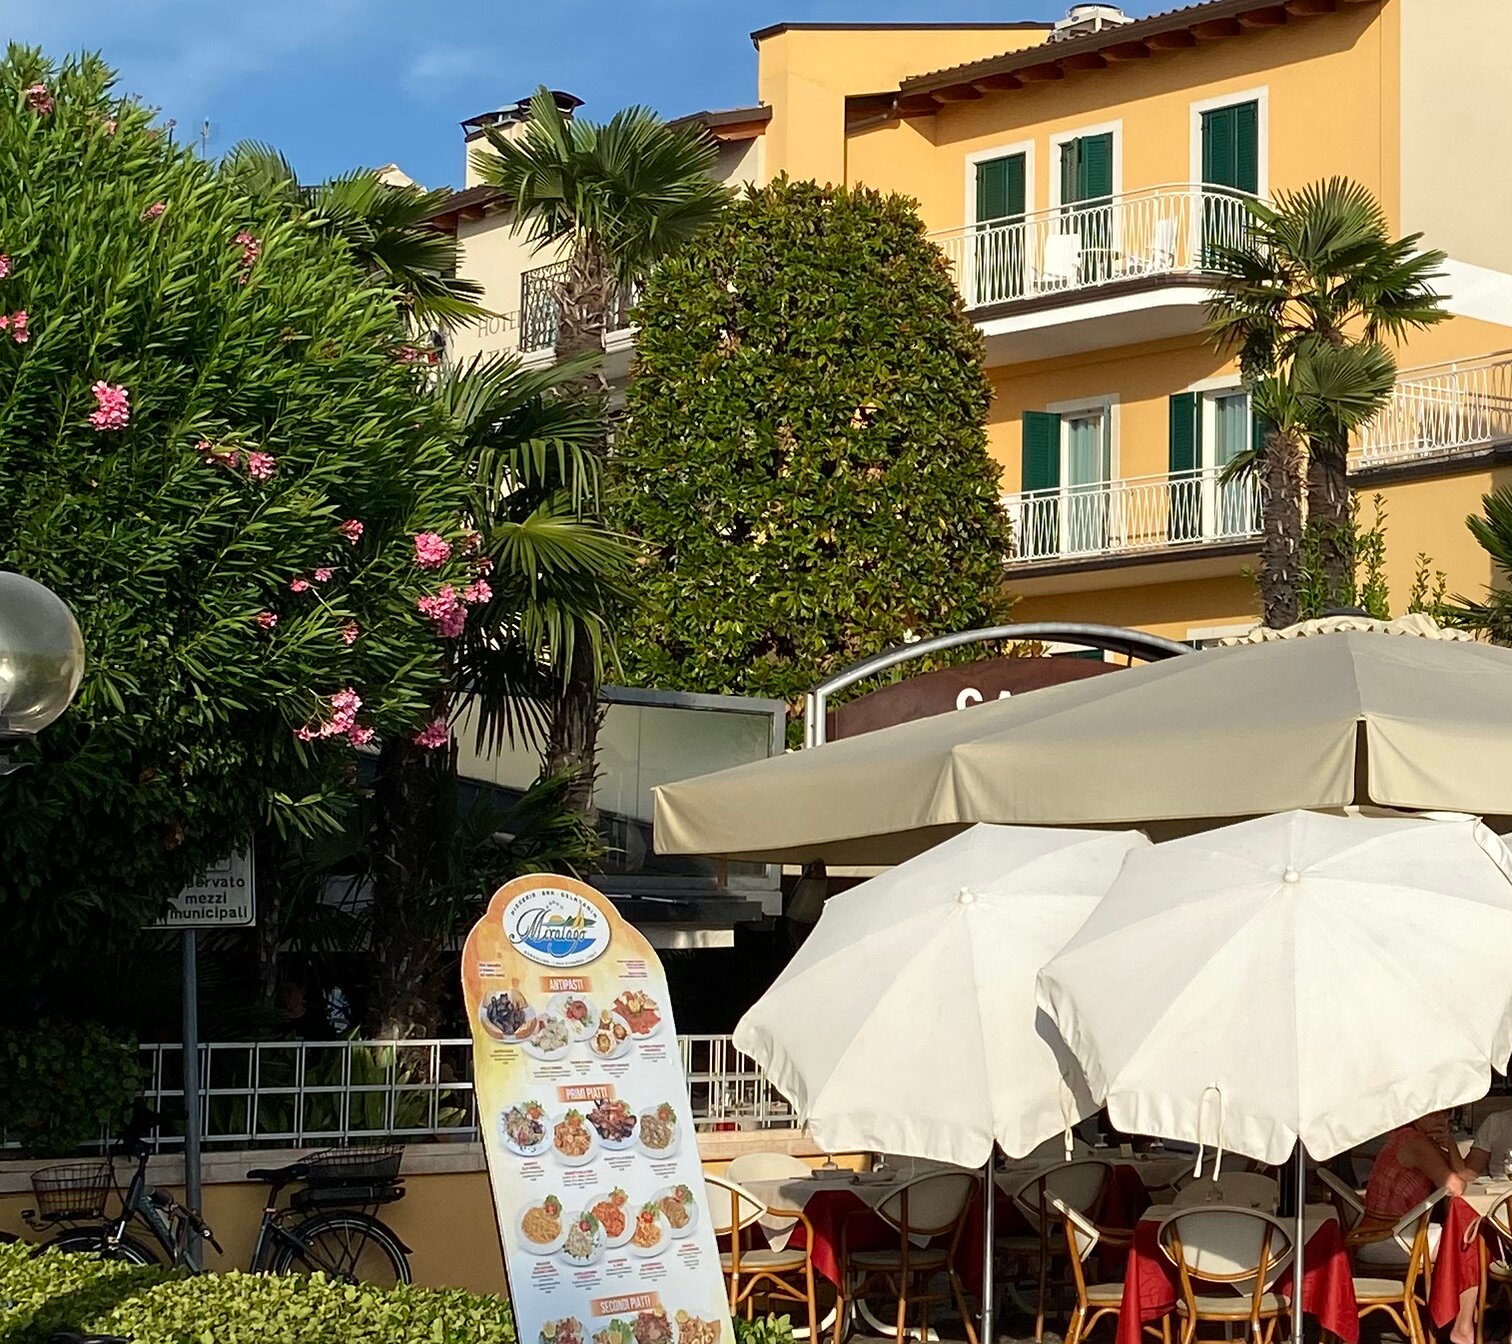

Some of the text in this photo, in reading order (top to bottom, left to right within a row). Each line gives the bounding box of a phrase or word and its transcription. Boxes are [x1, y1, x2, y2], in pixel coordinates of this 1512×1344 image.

[185, 891, 227, 904] mezzi
[170, 905, 248, 921] municipali
[508, 907, 588, 959] Miralago
[549, 977, 584, 992] ANTIPASTI
[586, 1086, 608, 1099] PIATTI
[600, 1295, 652, 1314] SECONDI PIATTI
